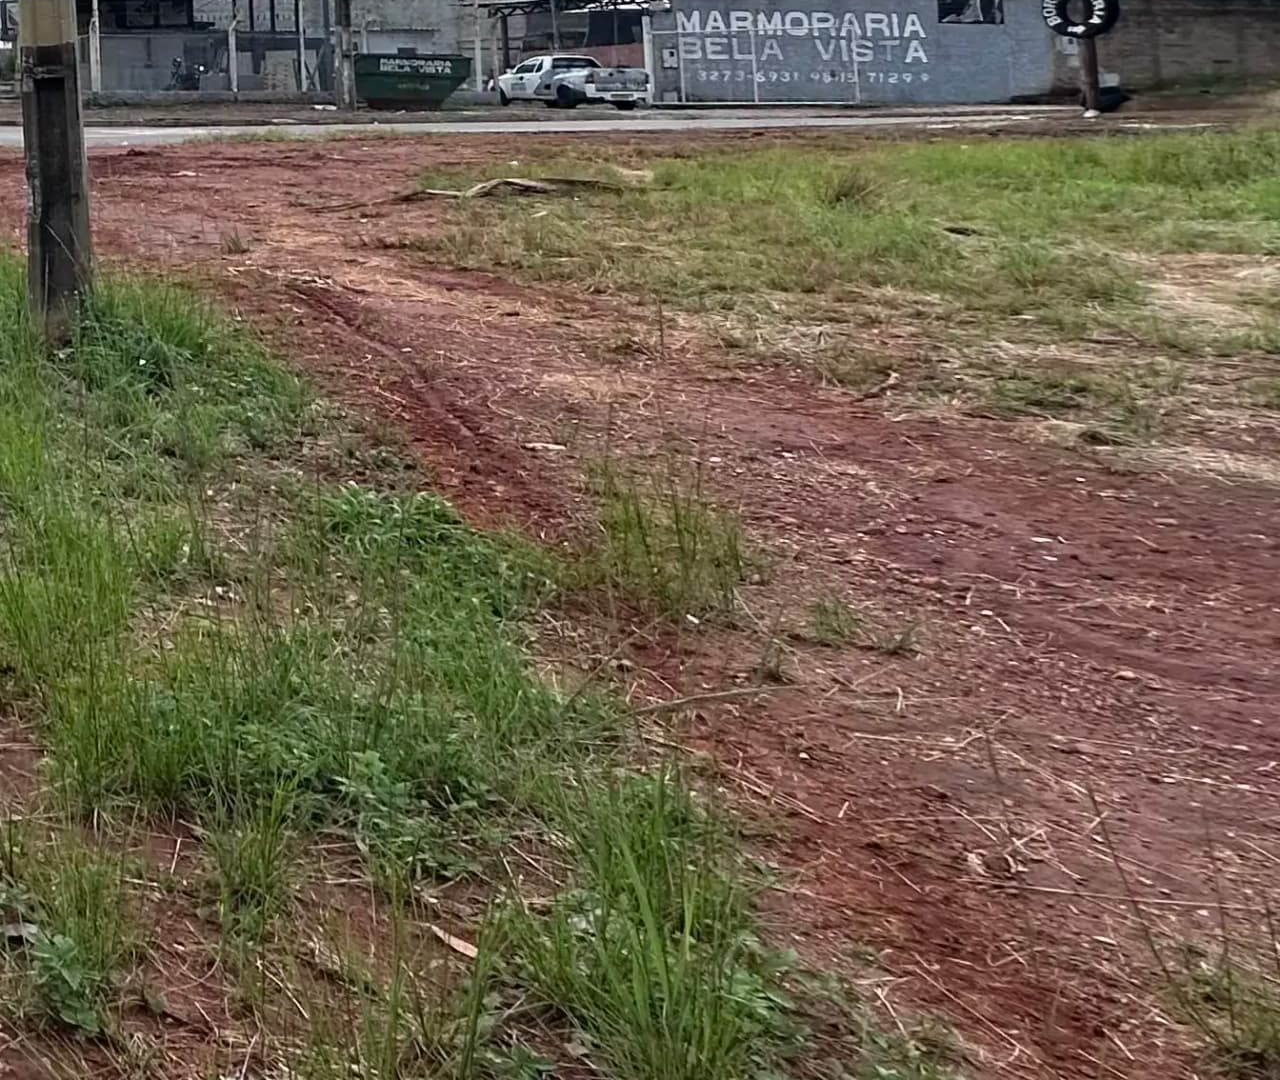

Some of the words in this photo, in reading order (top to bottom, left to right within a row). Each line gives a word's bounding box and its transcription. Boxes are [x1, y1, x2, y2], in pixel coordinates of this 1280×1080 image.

[676, 10, 927, 38] MARMORARIA
[679, 36, 784, 61] BELA
[814, 39, 929, 64] VISTA
